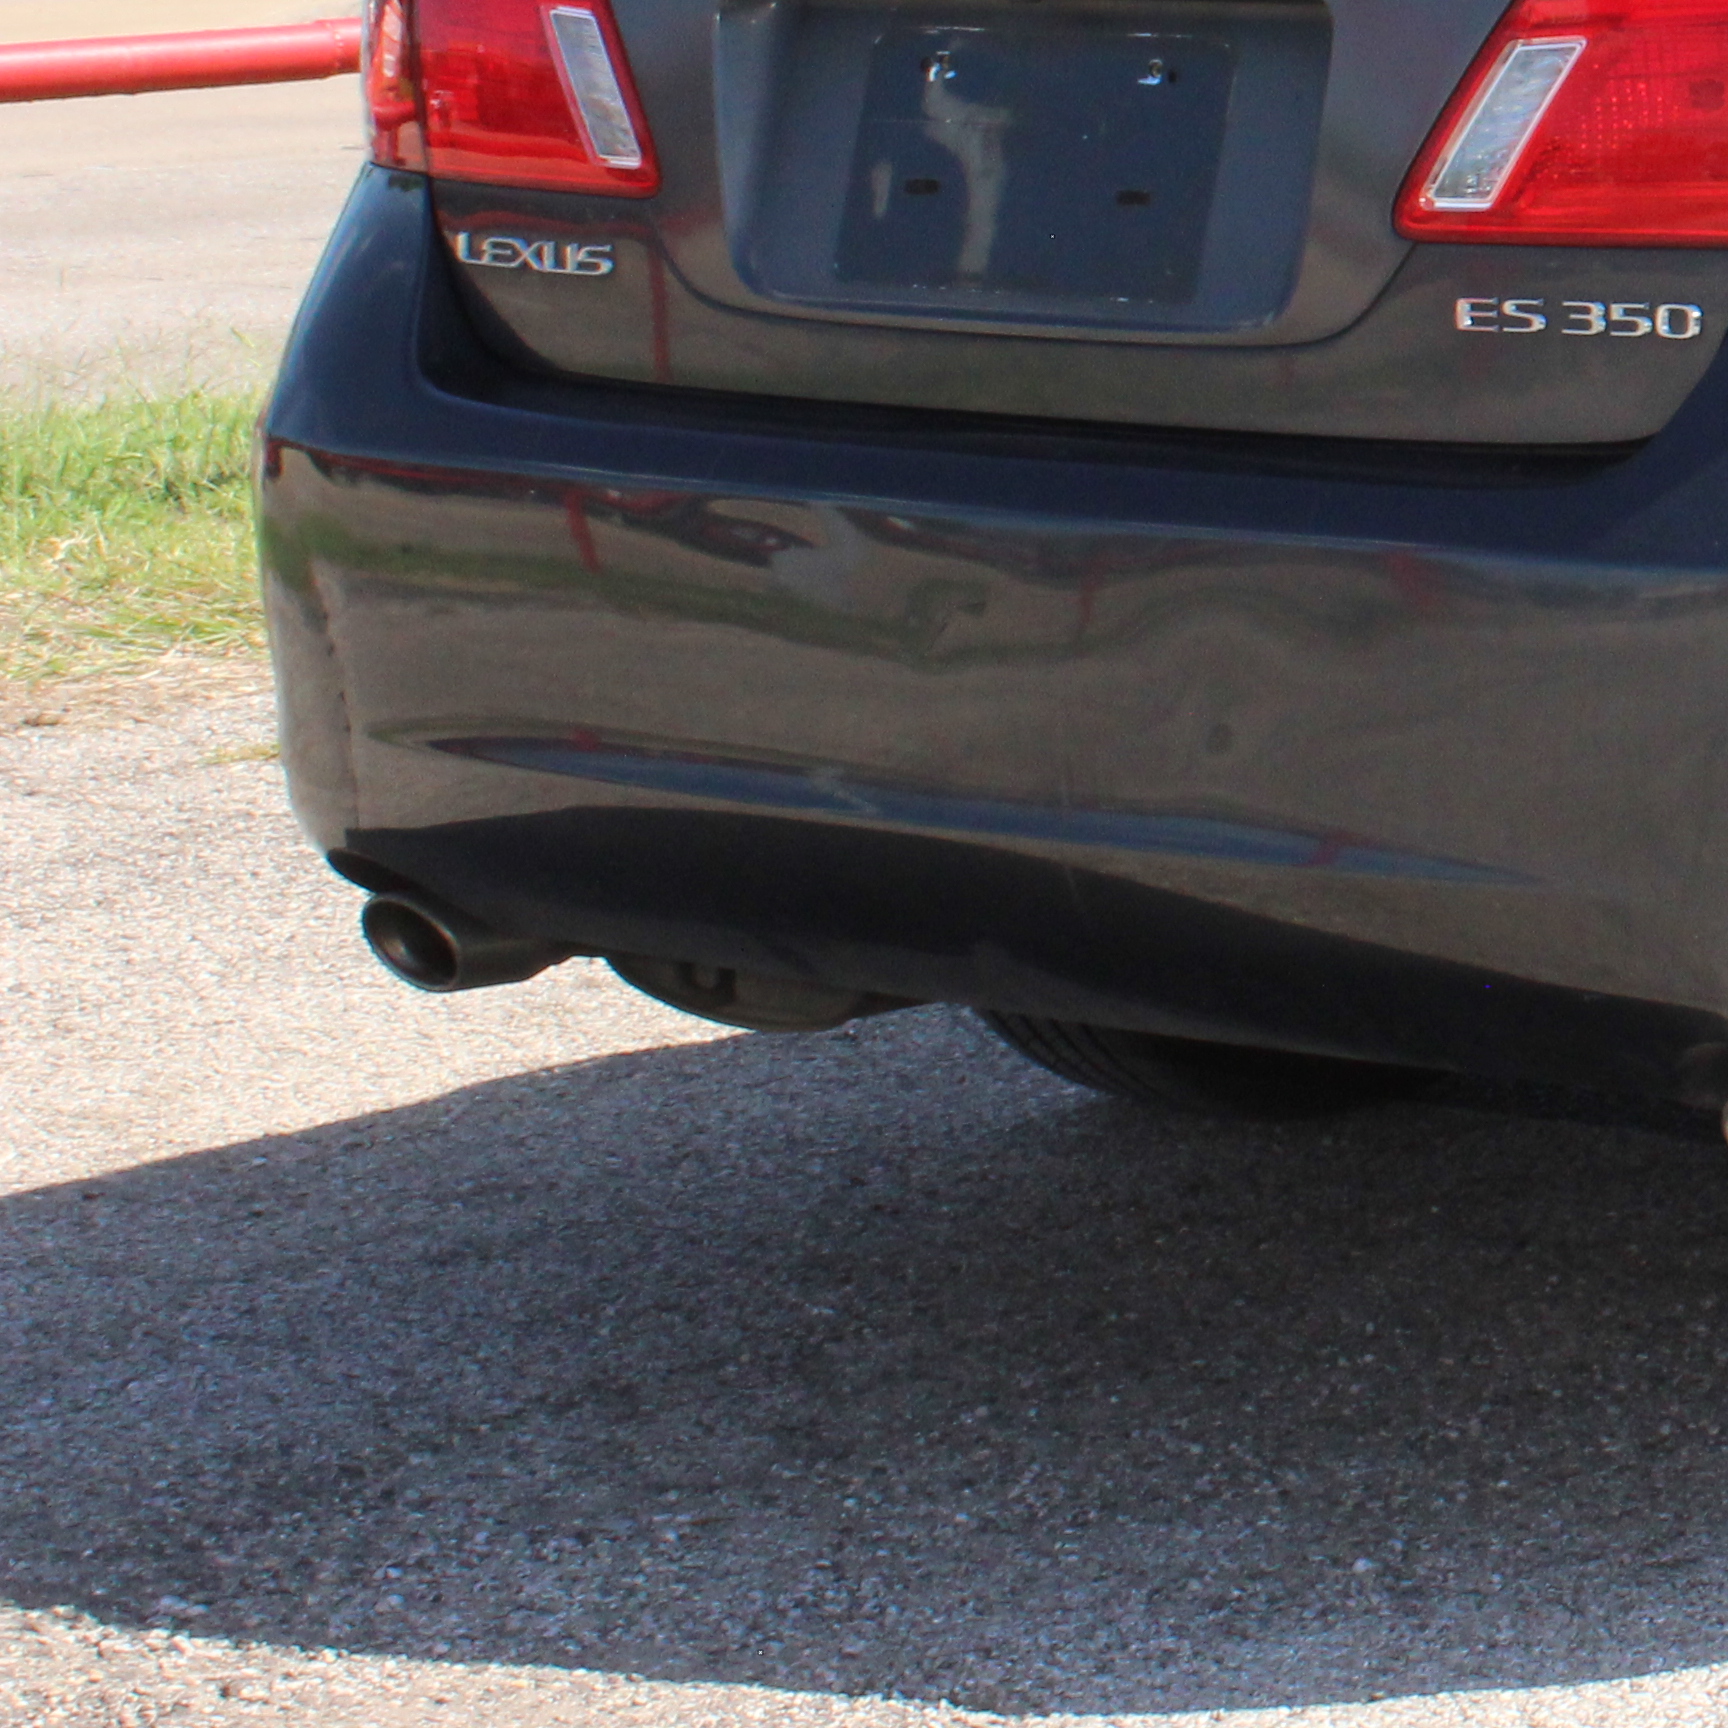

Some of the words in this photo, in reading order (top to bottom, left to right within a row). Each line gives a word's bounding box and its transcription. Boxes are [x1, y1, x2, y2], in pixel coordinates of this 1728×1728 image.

[455, 231, 615, 276] LEXUS
[1455, 297, 1547, 333] ES
[1561, 300, 1702, 339] 350
